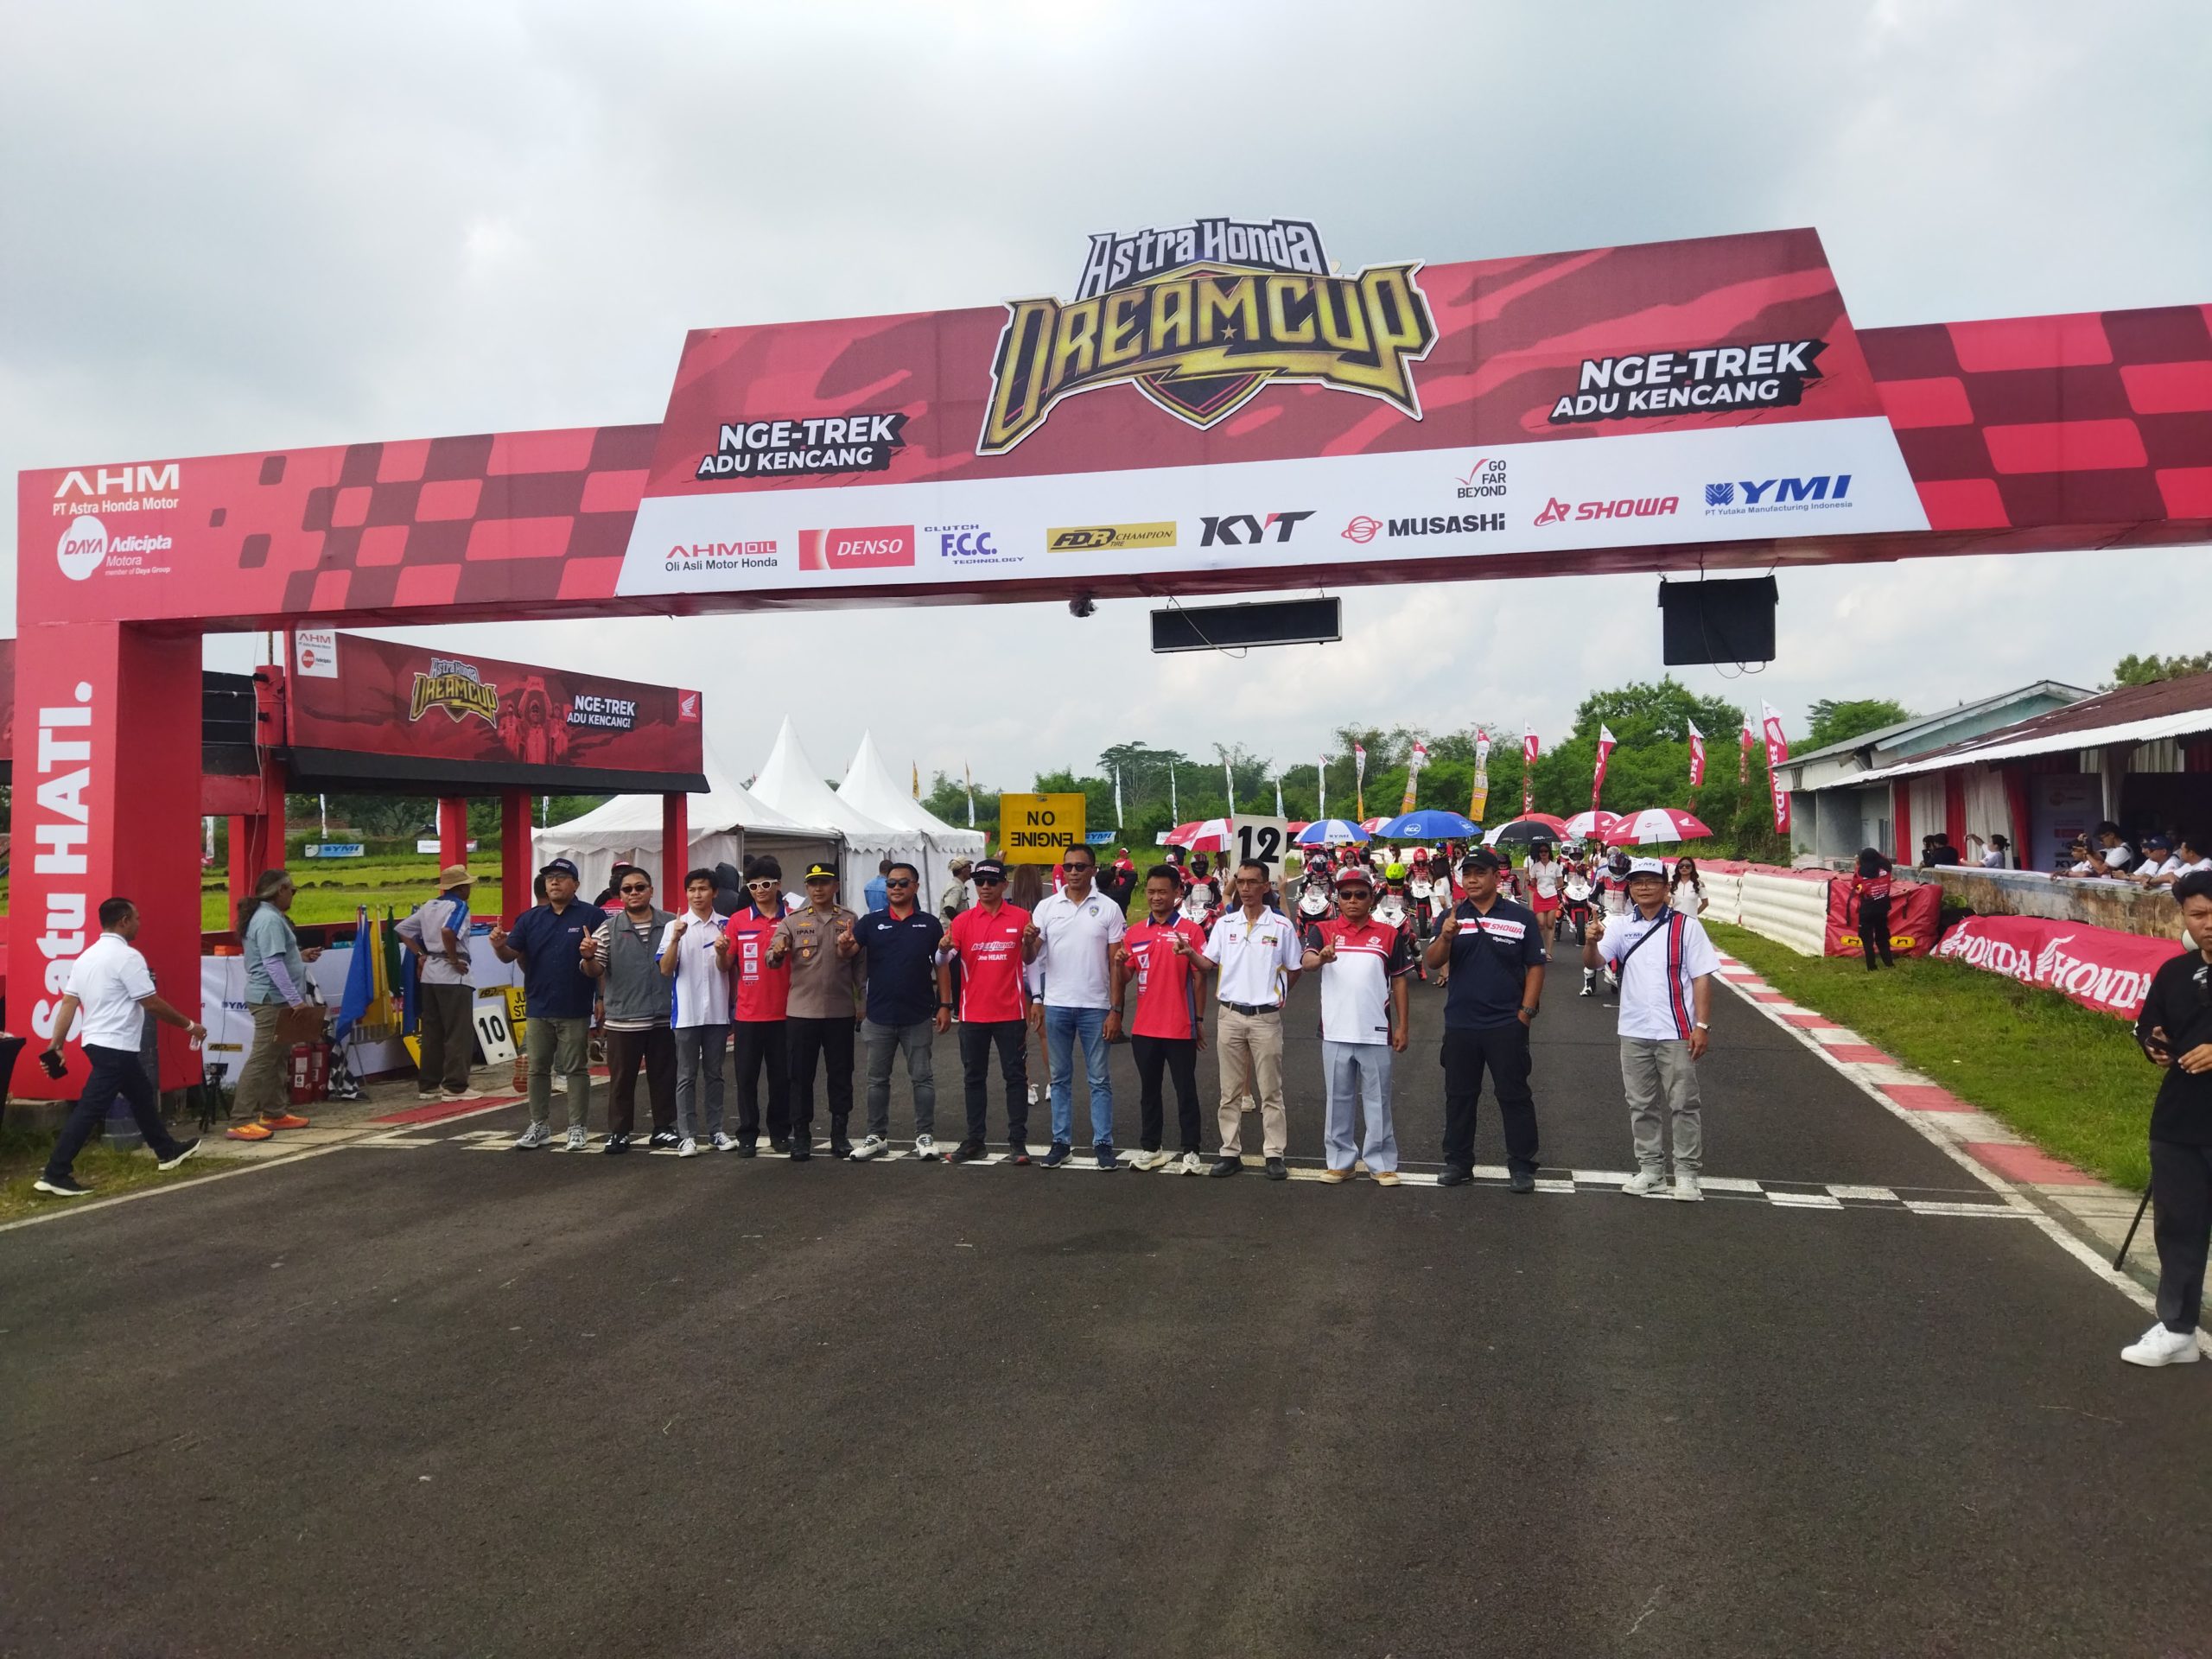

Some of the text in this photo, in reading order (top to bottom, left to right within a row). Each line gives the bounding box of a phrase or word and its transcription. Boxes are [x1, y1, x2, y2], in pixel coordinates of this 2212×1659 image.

[1082, 221, 1322, 299] Astra Honda
[1580, 340, 1811, 391] NGE-TREK
[1552, 379, 1780, 418] ADU KENCANG
[719, 414, 897, 451] NGE-TREK
[697, 447, 873, 474] ADU KENCANG
[1489, 460, 1507, 472] GO
[54, 464, 180, 499] AHM
[1482, 473, 1507, 485] FAR
[1457, 485, 1507, 499] BEYOND
[1738, 475, 1852, 505] YMI
[53, 497, 179, 516] PT Astra Honda Motor
[1575, 497, 1679, 521] SHOWA
[1718, 505, 1746, 517] Yutaka
[1747, 503, 1808, 514] Manufacturing
[1810, 500, 1853, 511] Indonesia
[925, 524, 979, 532] CLUTCH
[1116, 530, 1173, 541] CHAMPION
[1199, 511, 1318, 547] KYT
[64, 538, 103, 556] DAYA
[109, 535, 172, 554] Adicipta
[836, 538, 904, 556] DENSO
[105, 556, 142, 567] Motora
[151, 566, 170, 575] Group
[665, 557, 778, 571] Oli Asli Motor Honda
[299, 632, 331, 644] AHM
[431, 658, 454, 678] Astra
[575, 695, 636, 716] NGE-TREK
[567, 712, 631, 728] ADU KENCANG!
[1770, 745, 1786, 825] HNDA
[1011, 831, 1073, 847] ENGINE
[1237, 825, 1281, 863] 12
[1491, 922, 1522, 934] SHOWA
[31, 893, 86, 1043] Satu
[1955, 936, 2032, 982] HONDA
[479, 1015, 505, 1045] 10
